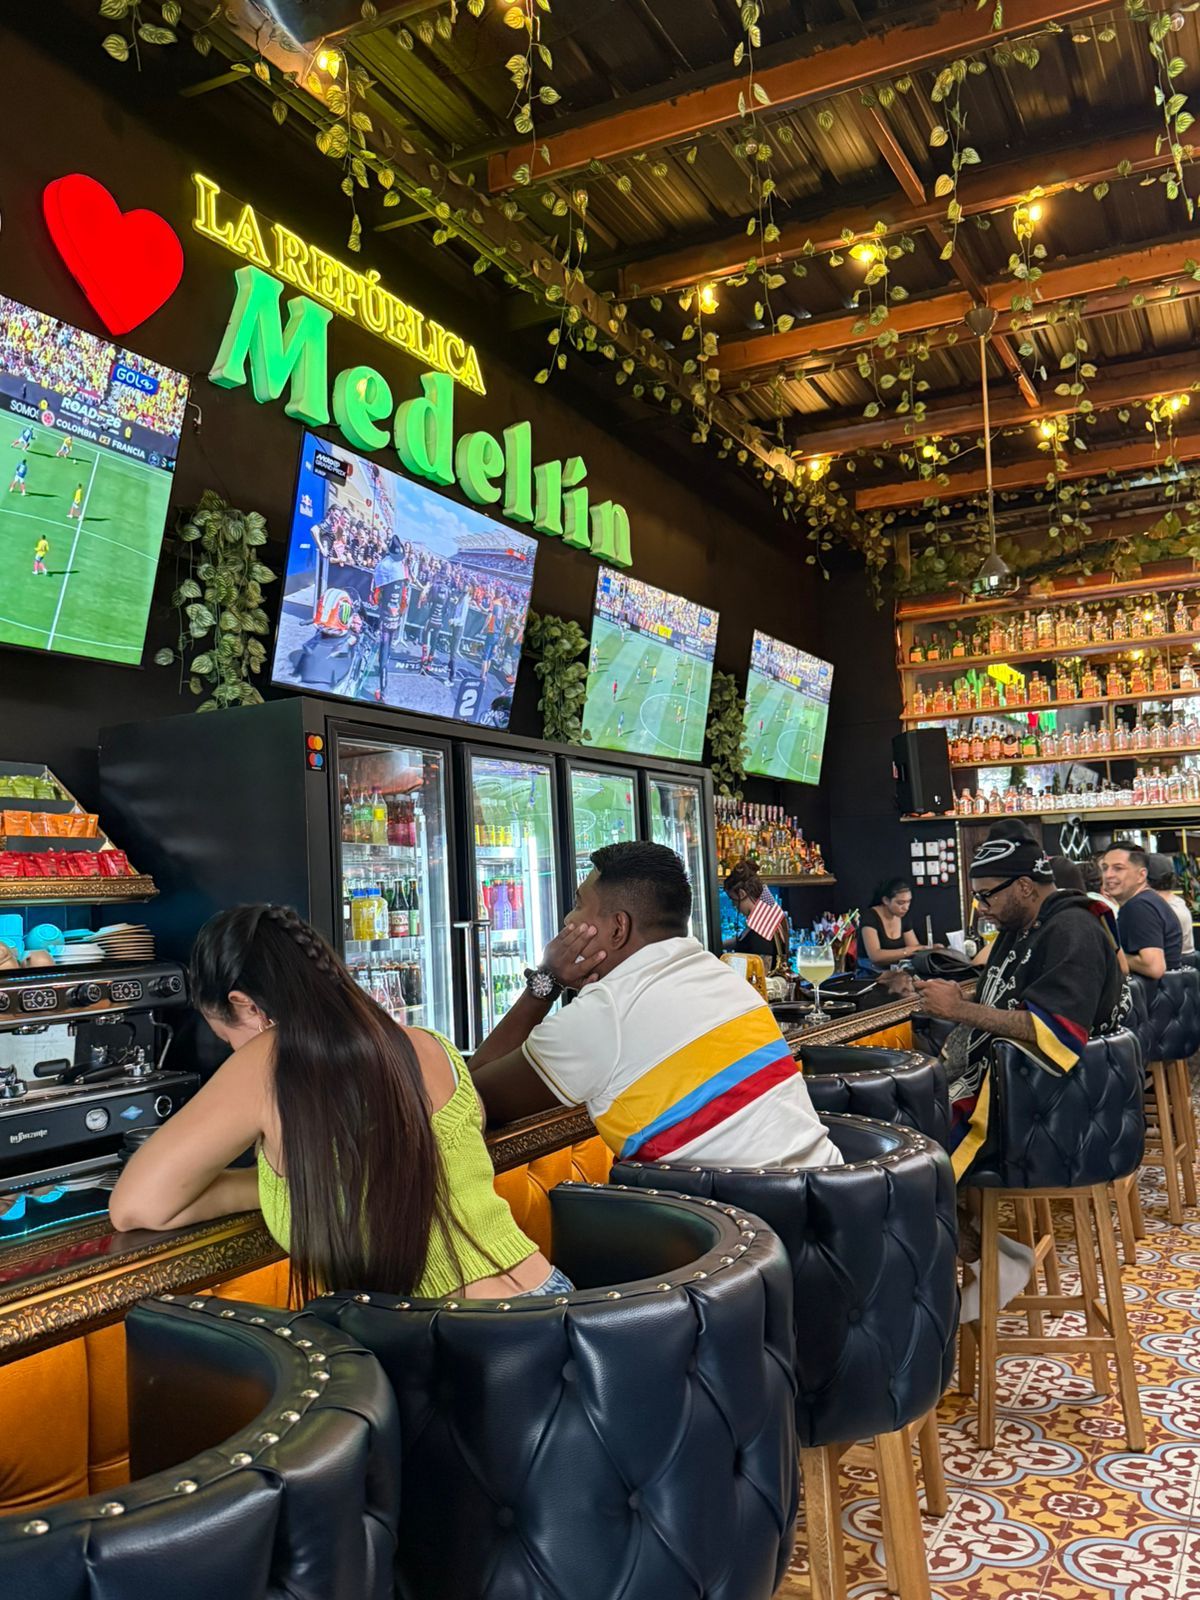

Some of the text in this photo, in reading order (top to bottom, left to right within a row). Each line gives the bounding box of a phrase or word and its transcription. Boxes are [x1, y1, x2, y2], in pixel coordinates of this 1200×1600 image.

[192, 173, 486, 396] LA REPÚBLICA
[116, 367, 142, 388] GOL
[61, 397, 100, 420] ROAD
[105, 414, 122, 429] 26
[208, 265, 633, 568] Medellín
[56, 418, 98, 441] COLOMBIA
[111, 439, 146, 459] FRANCIA
[459, 688, 478, 717] 2
